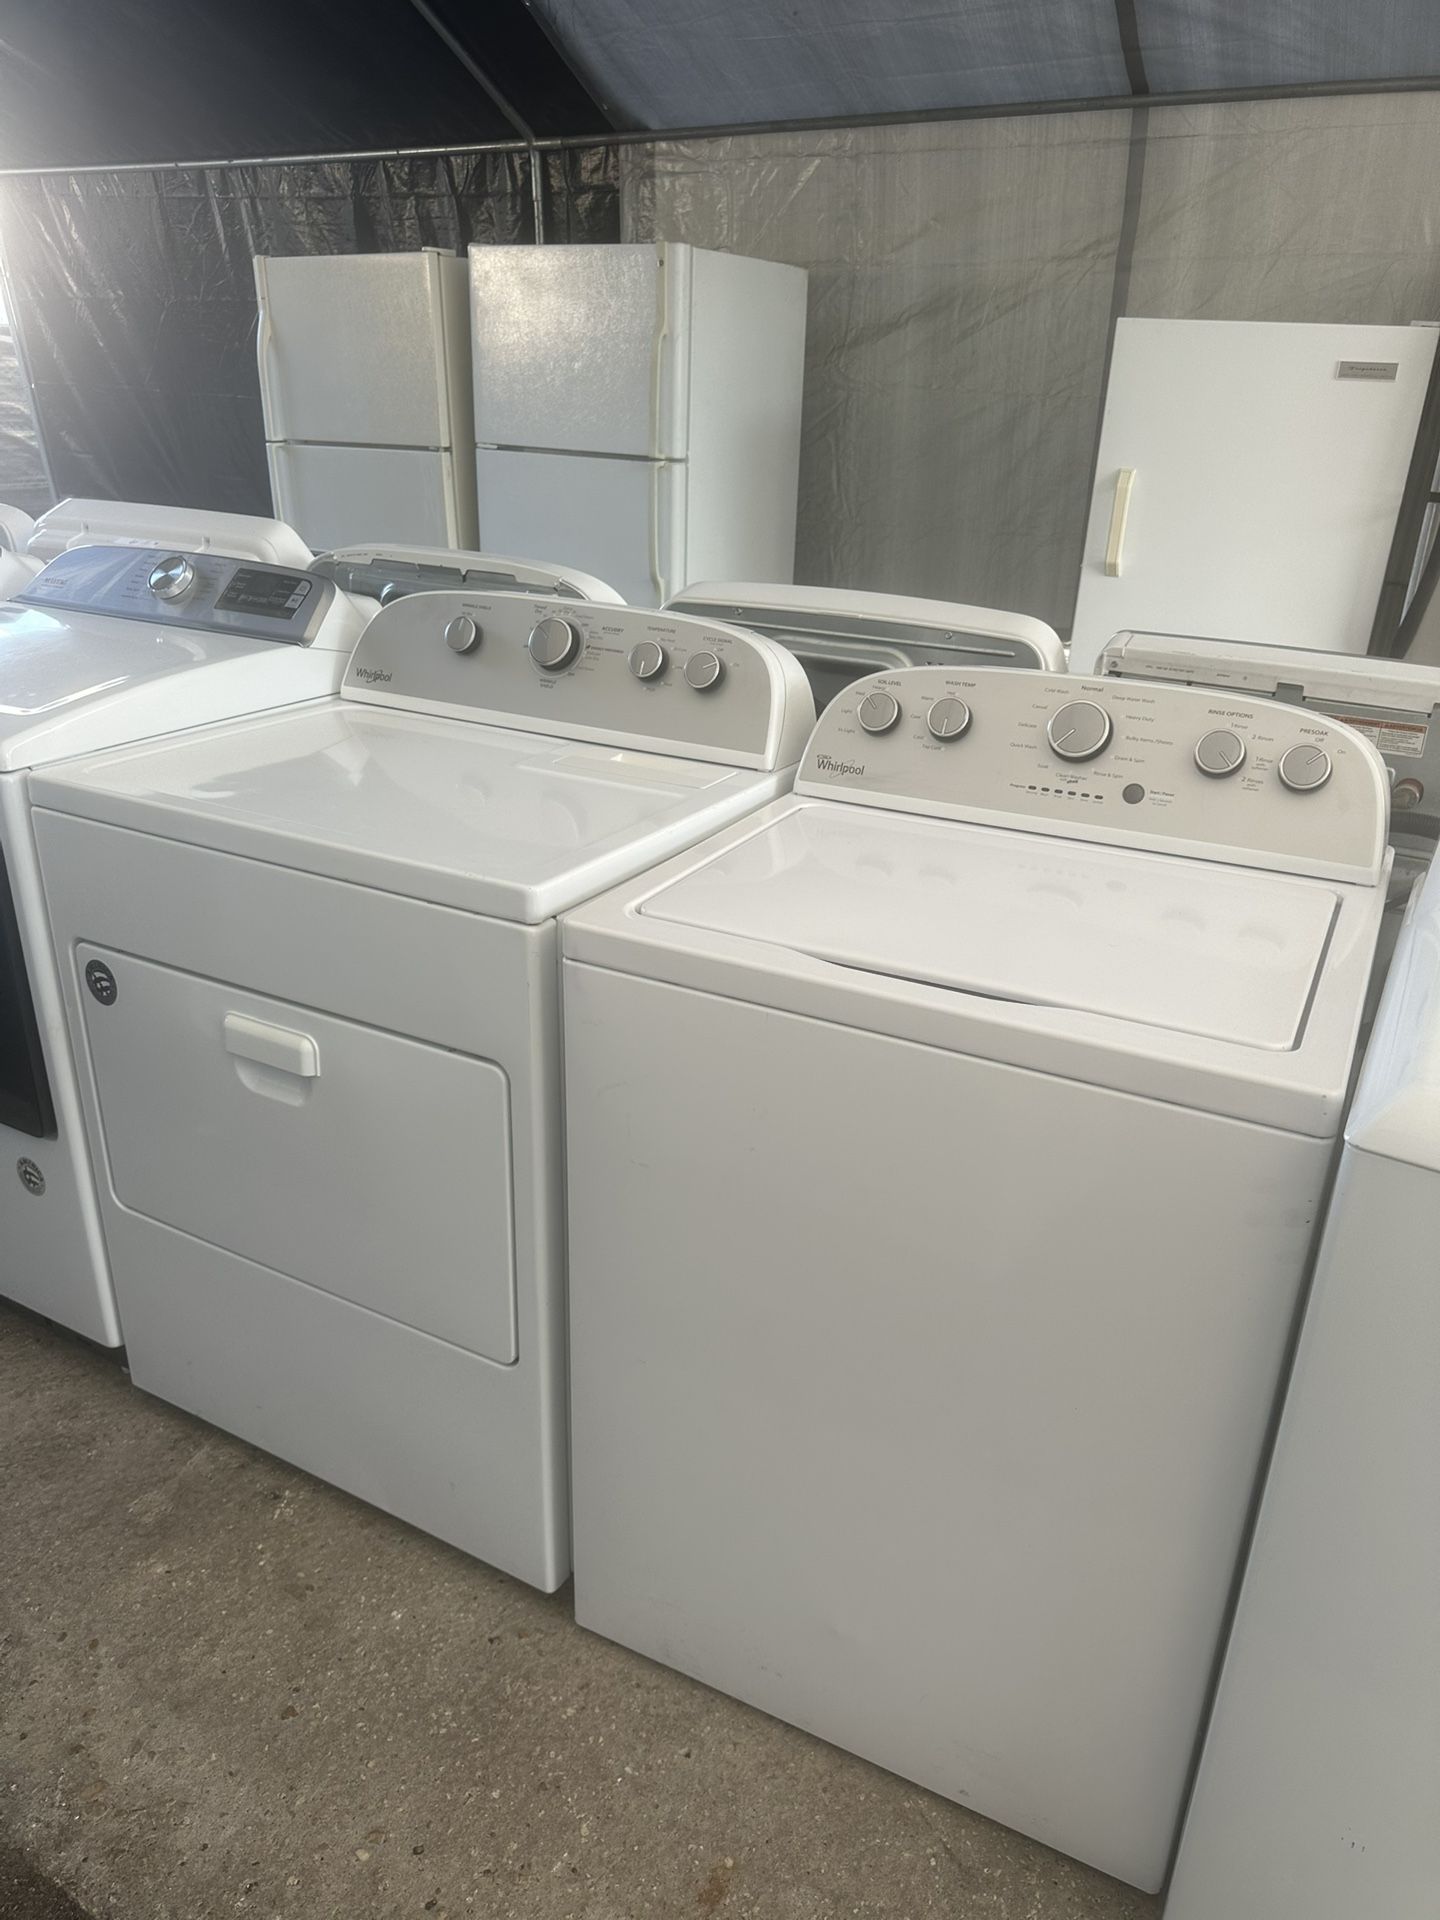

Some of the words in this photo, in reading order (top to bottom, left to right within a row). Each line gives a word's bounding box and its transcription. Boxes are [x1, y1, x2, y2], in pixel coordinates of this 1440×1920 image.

[356, 667, 392, 683] Whirlpool
[1081, 685, 1104, 693] Normal
[1208, 709, 1225, 717] RINSE
[1300, 728, 1329, 737] PRESOAK
[817, 759, 865, 777] Whirlpool
